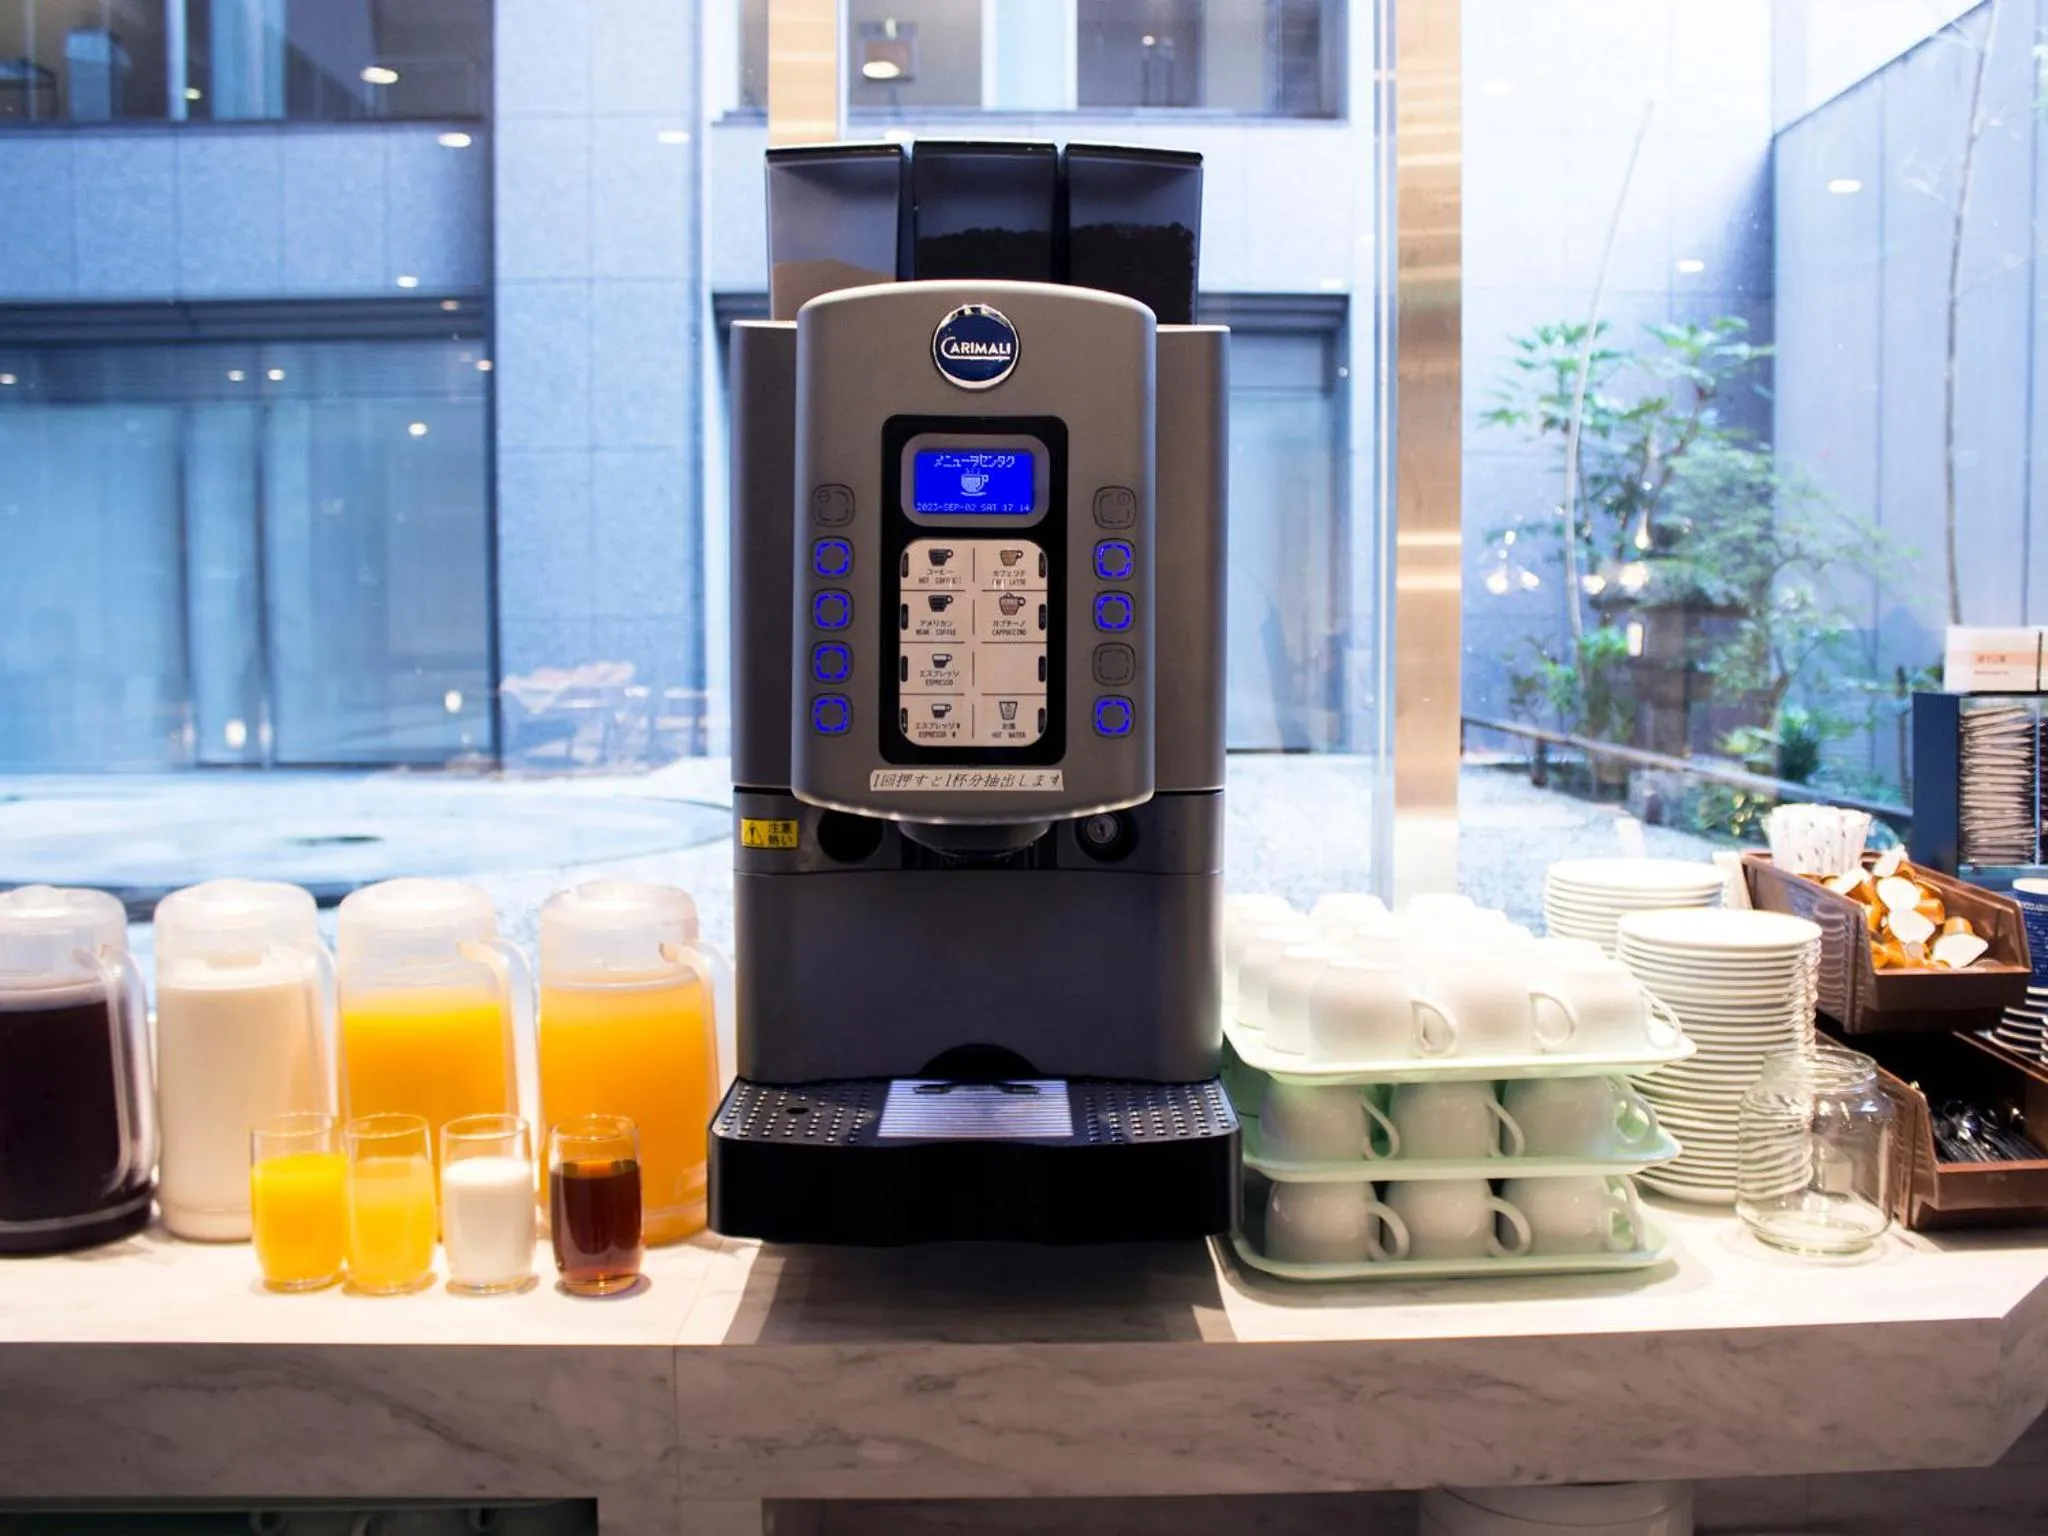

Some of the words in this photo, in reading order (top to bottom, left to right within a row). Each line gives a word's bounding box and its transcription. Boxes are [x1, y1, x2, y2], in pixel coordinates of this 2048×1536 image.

[941, 336, 1011, 360] CARIMALI
[980, 503, 997, 513] SAT
[872, 772, 1061, 789] 1回押すと1杯分抽出します
